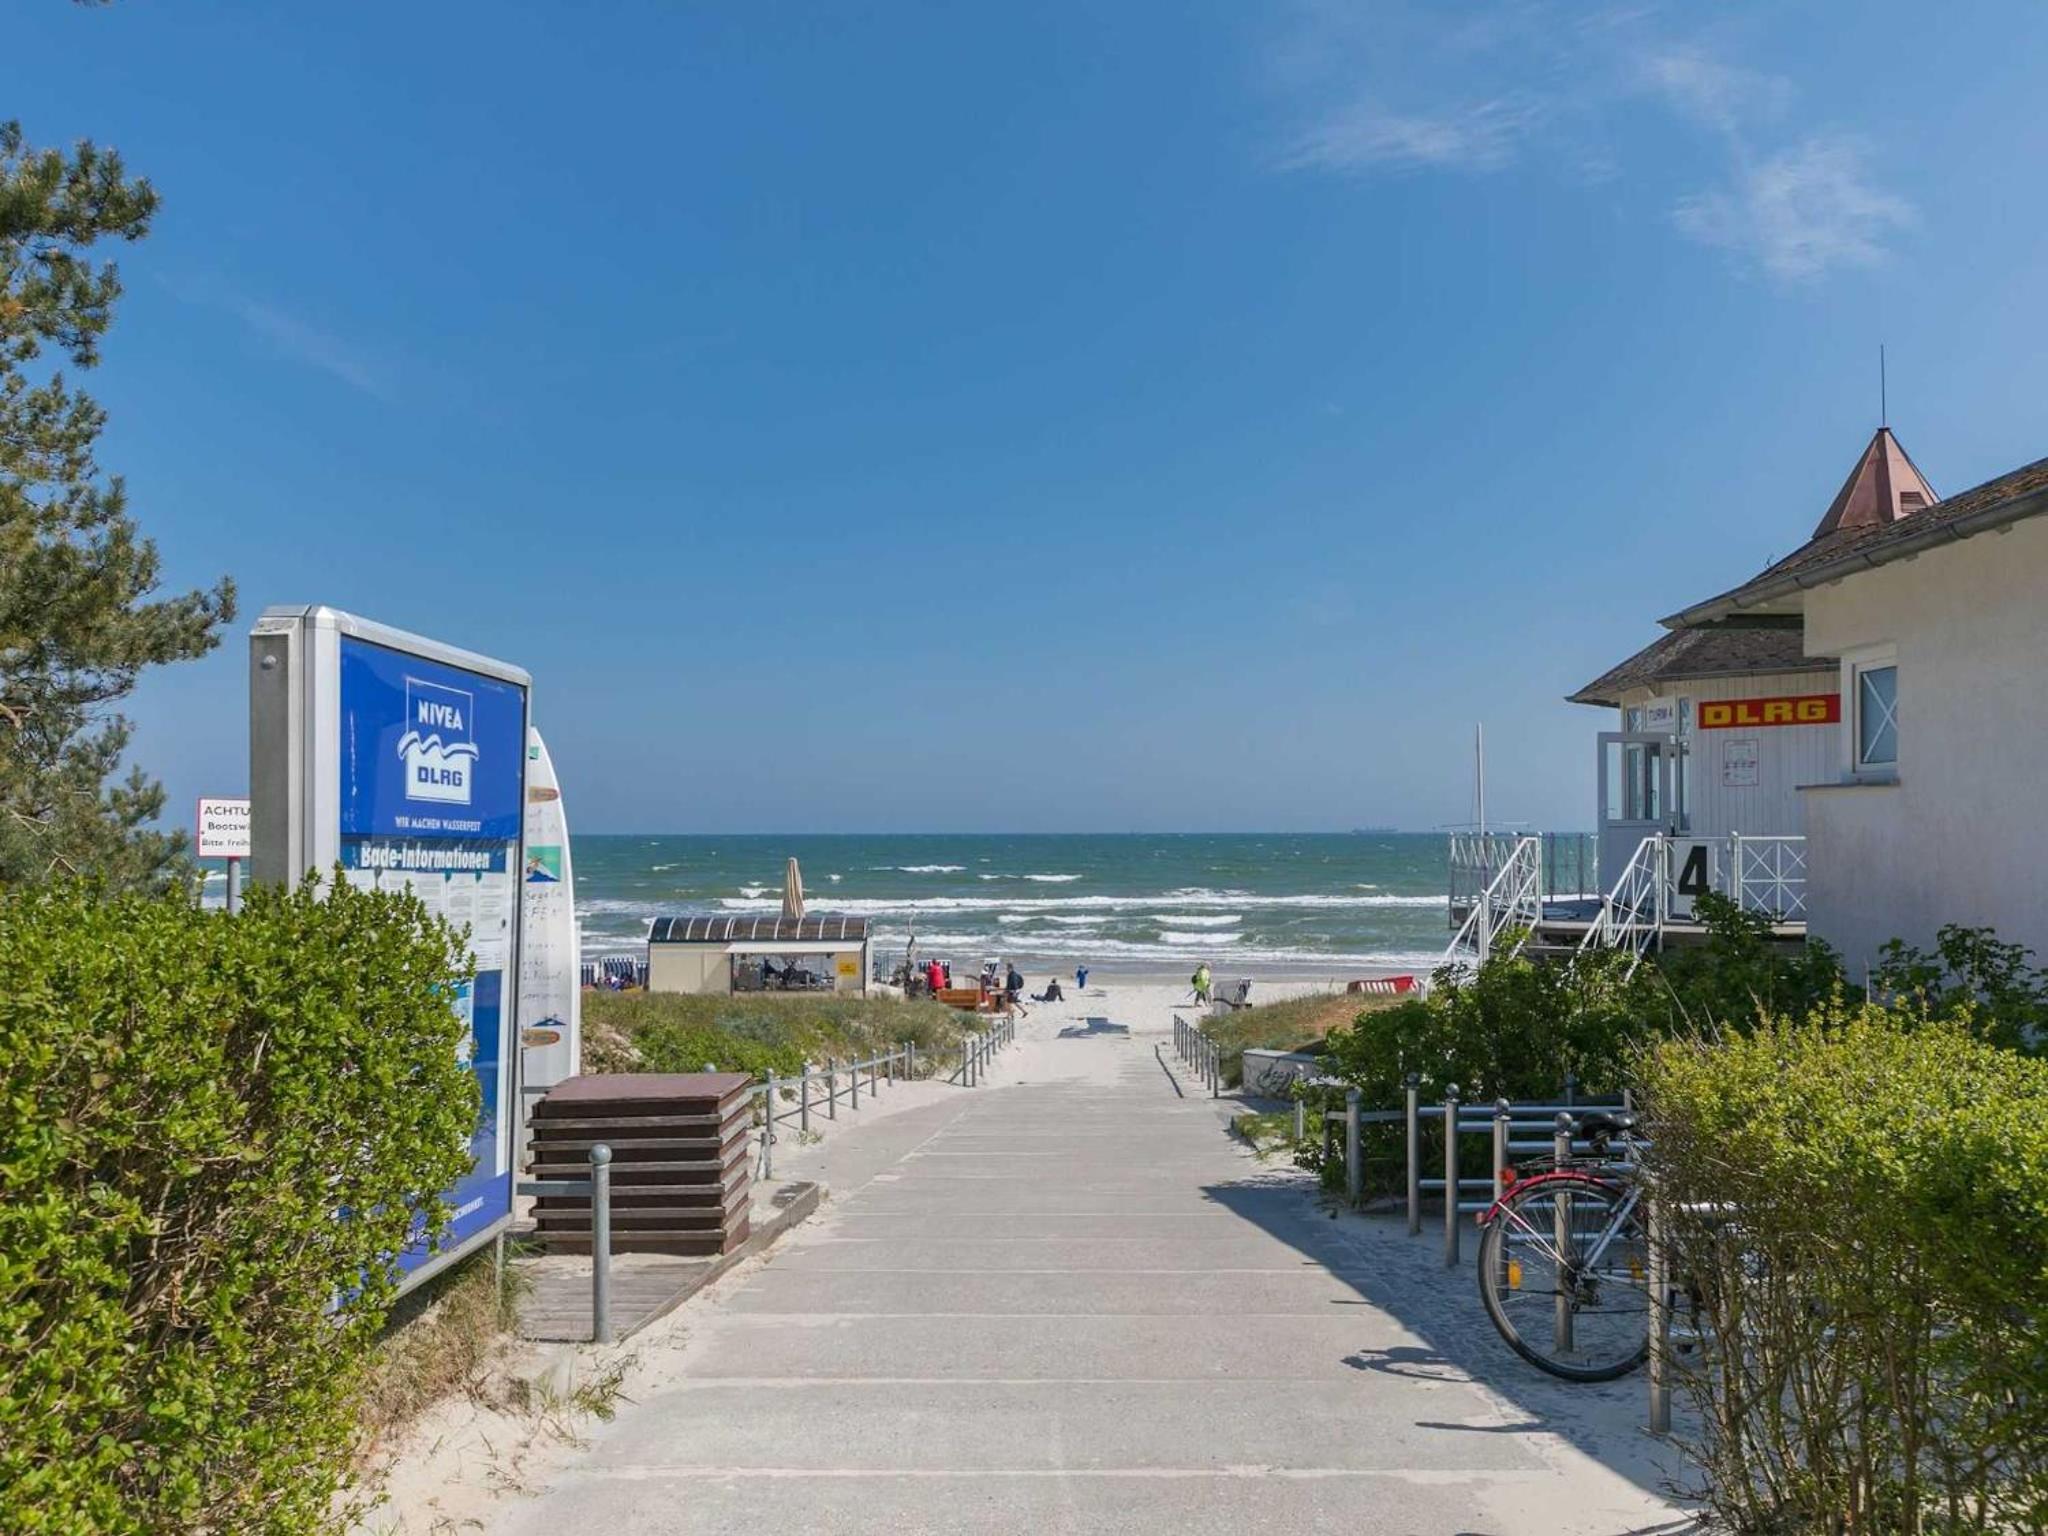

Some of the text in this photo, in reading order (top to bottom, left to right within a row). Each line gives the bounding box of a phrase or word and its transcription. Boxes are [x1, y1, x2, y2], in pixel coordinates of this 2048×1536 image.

[418, 700, 464, 731] NIVEA
[1704, 700, 1827, 725] DLRG
[417, 766, 463, 787] DLRG
[395, 816, 481, 832] WIR MACHEN WASSERFEST
[202, 839, 223, 847] Bitte
[361, 841, 490, 869] Bade-Informationen
[1678, 846, 1710, 896] 4
